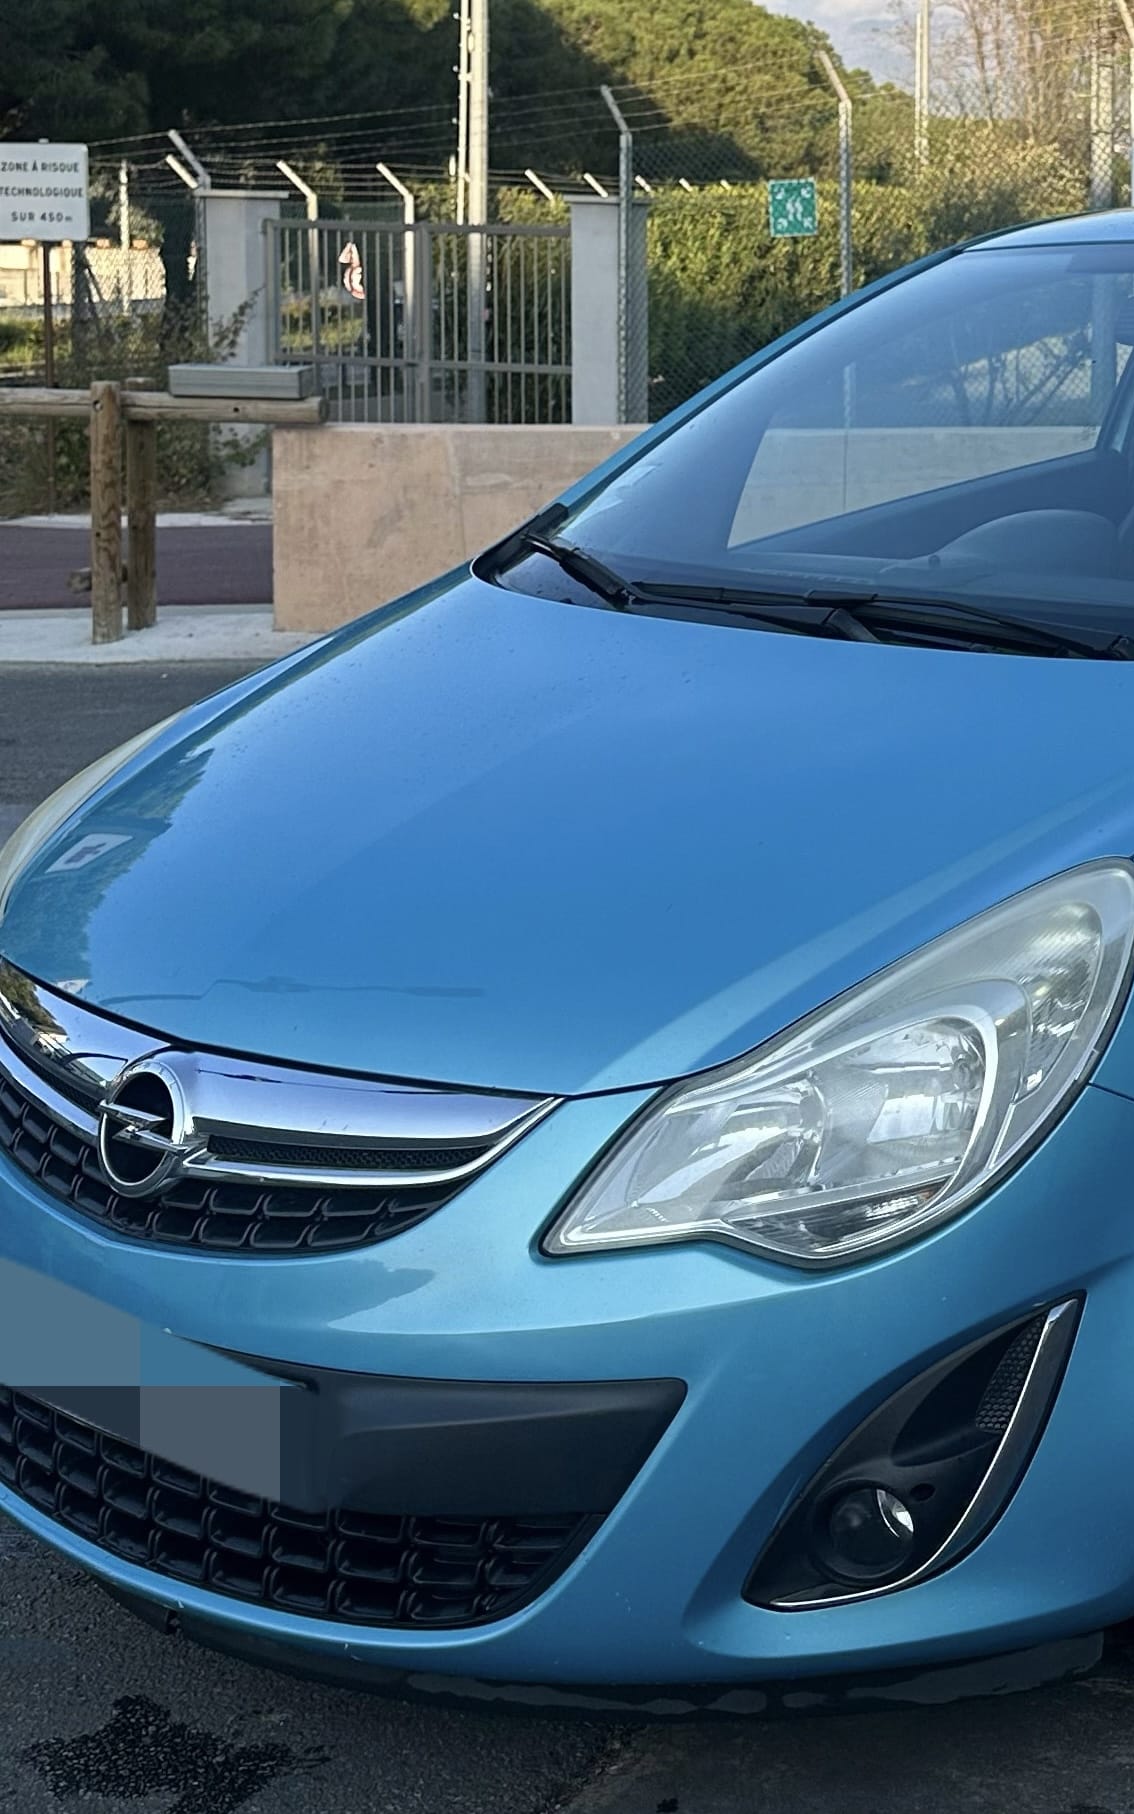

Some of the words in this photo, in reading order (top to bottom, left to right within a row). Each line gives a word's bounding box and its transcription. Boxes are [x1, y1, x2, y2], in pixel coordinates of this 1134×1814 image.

[1, 161, 28, 172] ZONE
[41, 162, 79, 172] RISQUE
[0, 187, 83, 198] TECHNOLOGIQUE
[11, 211, 35, 222] SUR
